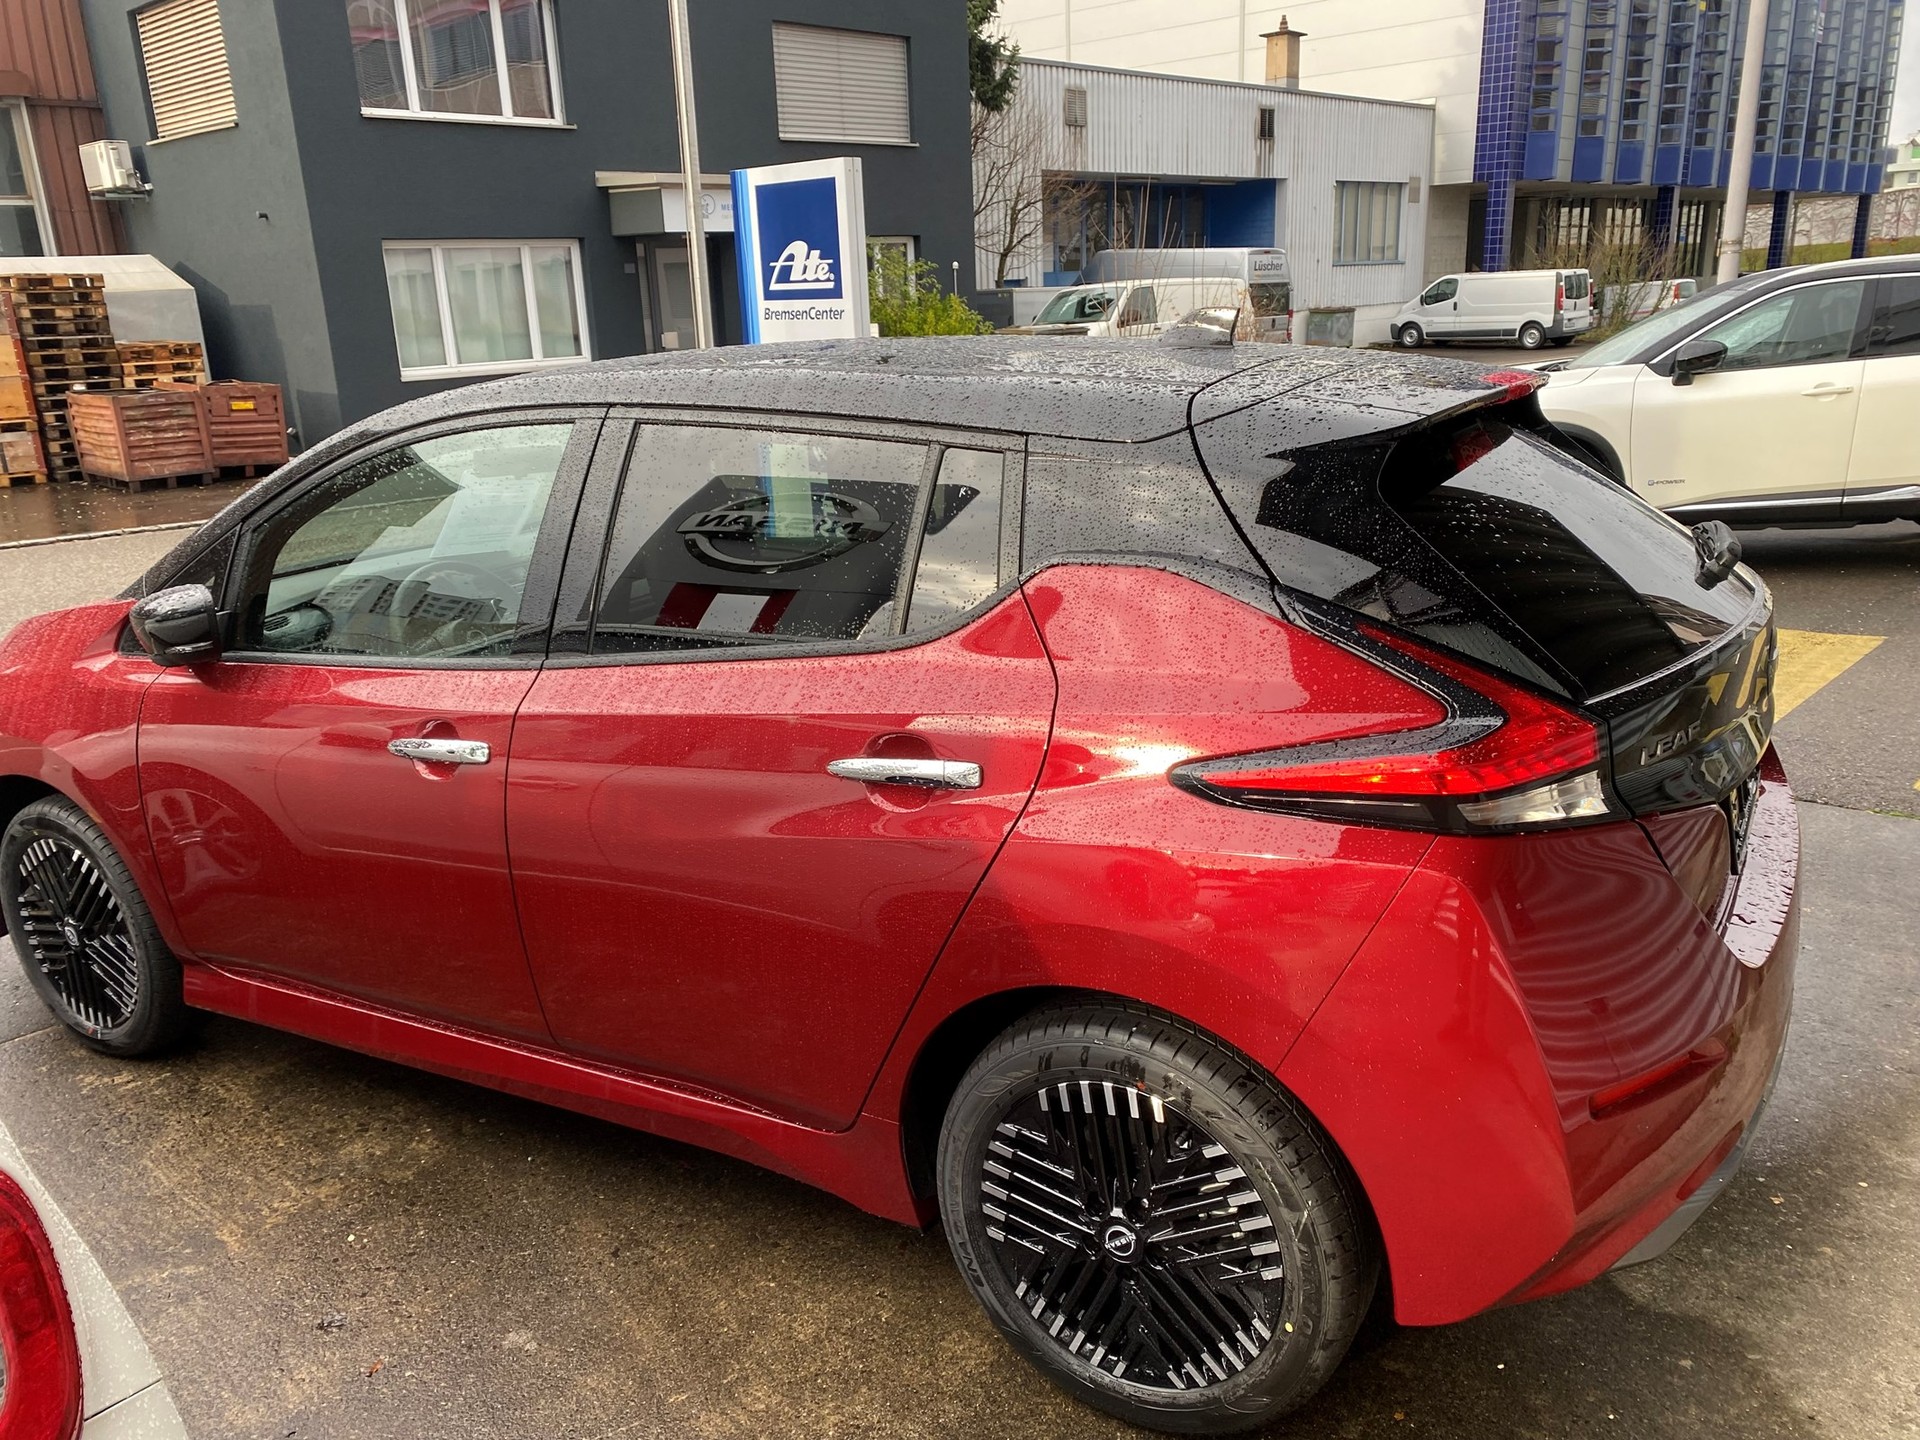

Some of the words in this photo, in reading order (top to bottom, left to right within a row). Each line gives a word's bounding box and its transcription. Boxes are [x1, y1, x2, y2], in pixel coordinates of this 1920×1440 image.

[1253, 260, 1283, 271] Lüscher
[763, 306, 845, 321] BremsenCenter
[1640, 720, 1701, 768] LEAF
